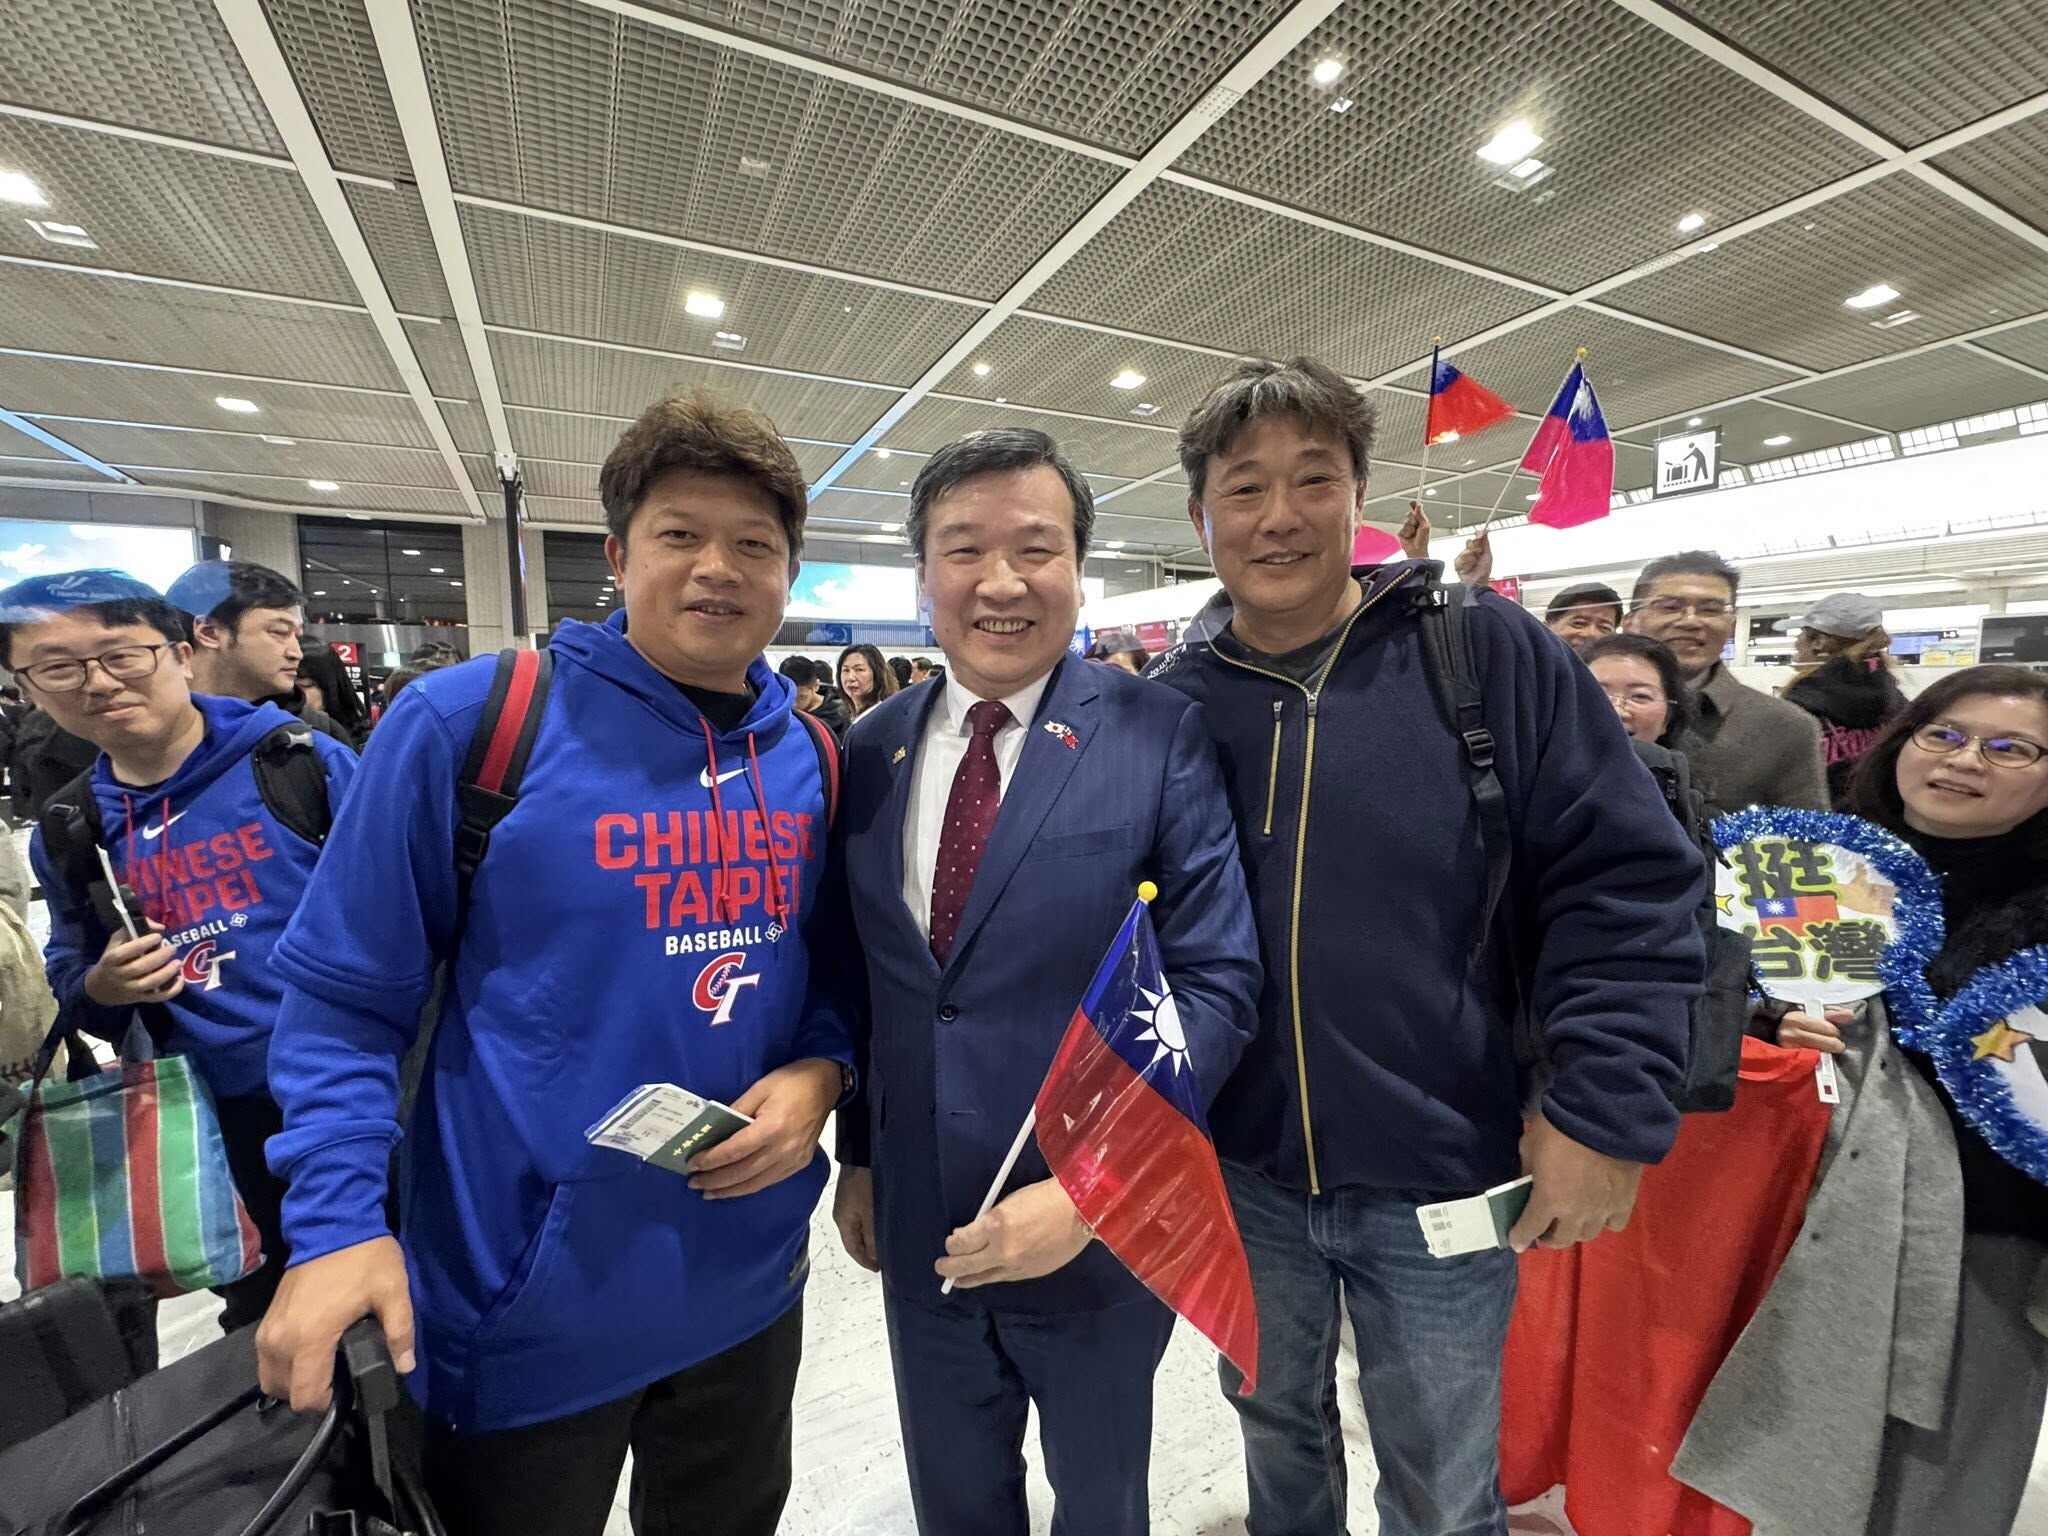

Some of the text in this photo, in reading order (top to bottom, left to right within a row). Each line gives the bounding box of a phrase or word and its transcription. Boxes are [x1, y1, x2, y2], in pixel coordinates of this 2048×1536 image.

[338, 645, 353, 661] 2
[594, 809, 818, 870] CHINESE
[634, 864, 800, 929] TAIPEI
[160, 919, 229, 948] ASEBALL
[665, 925, 762, 956] BASEBALL
[1743, 919, 1888, 981] 台灣
